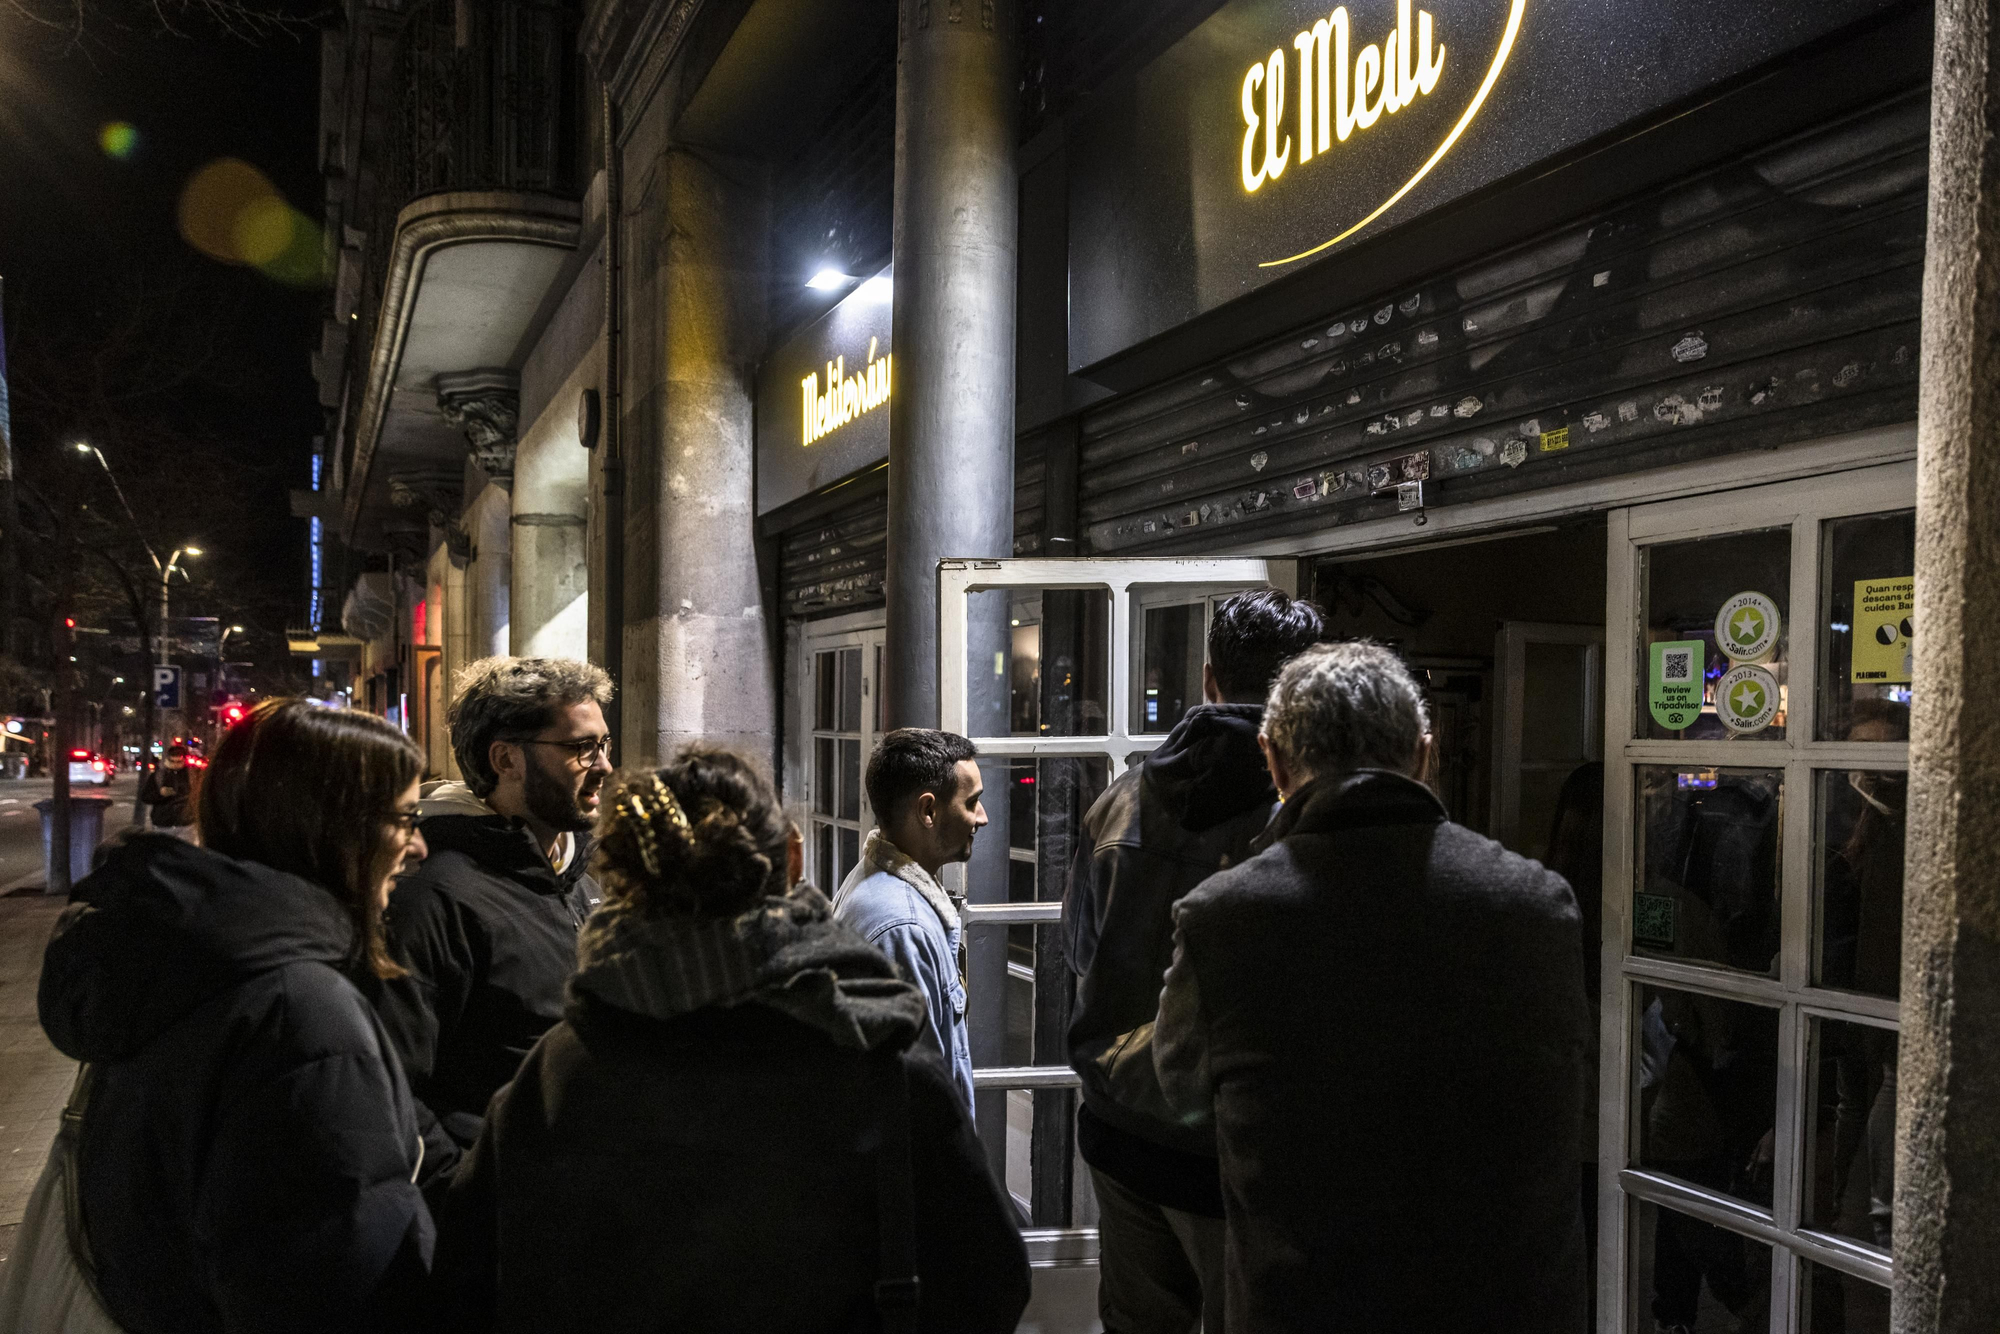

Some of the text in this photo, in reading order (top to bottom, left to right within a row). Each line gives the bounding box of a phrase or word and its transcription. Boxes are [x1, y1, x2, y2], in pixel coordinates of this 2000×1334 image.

[1241, 0, 1446, 192] El Medi
[1866, 583, 1914, 595] Quan resp
[1738, 597, 1758, 606] 2014
[1862, 594, 1902, 603] descans
[1864, 603, 1896, 612] cuides
[1729, 642, 1765, 656] Salir.com
[153, 668, 175, 692] P
[1732, 670, 1753, 682] 2013
[1662, 685, 1691, 694] Review
[1654, 701, 1699, 711] Tripadvisor
[1734, 711, 1770, 728] Salir.com
